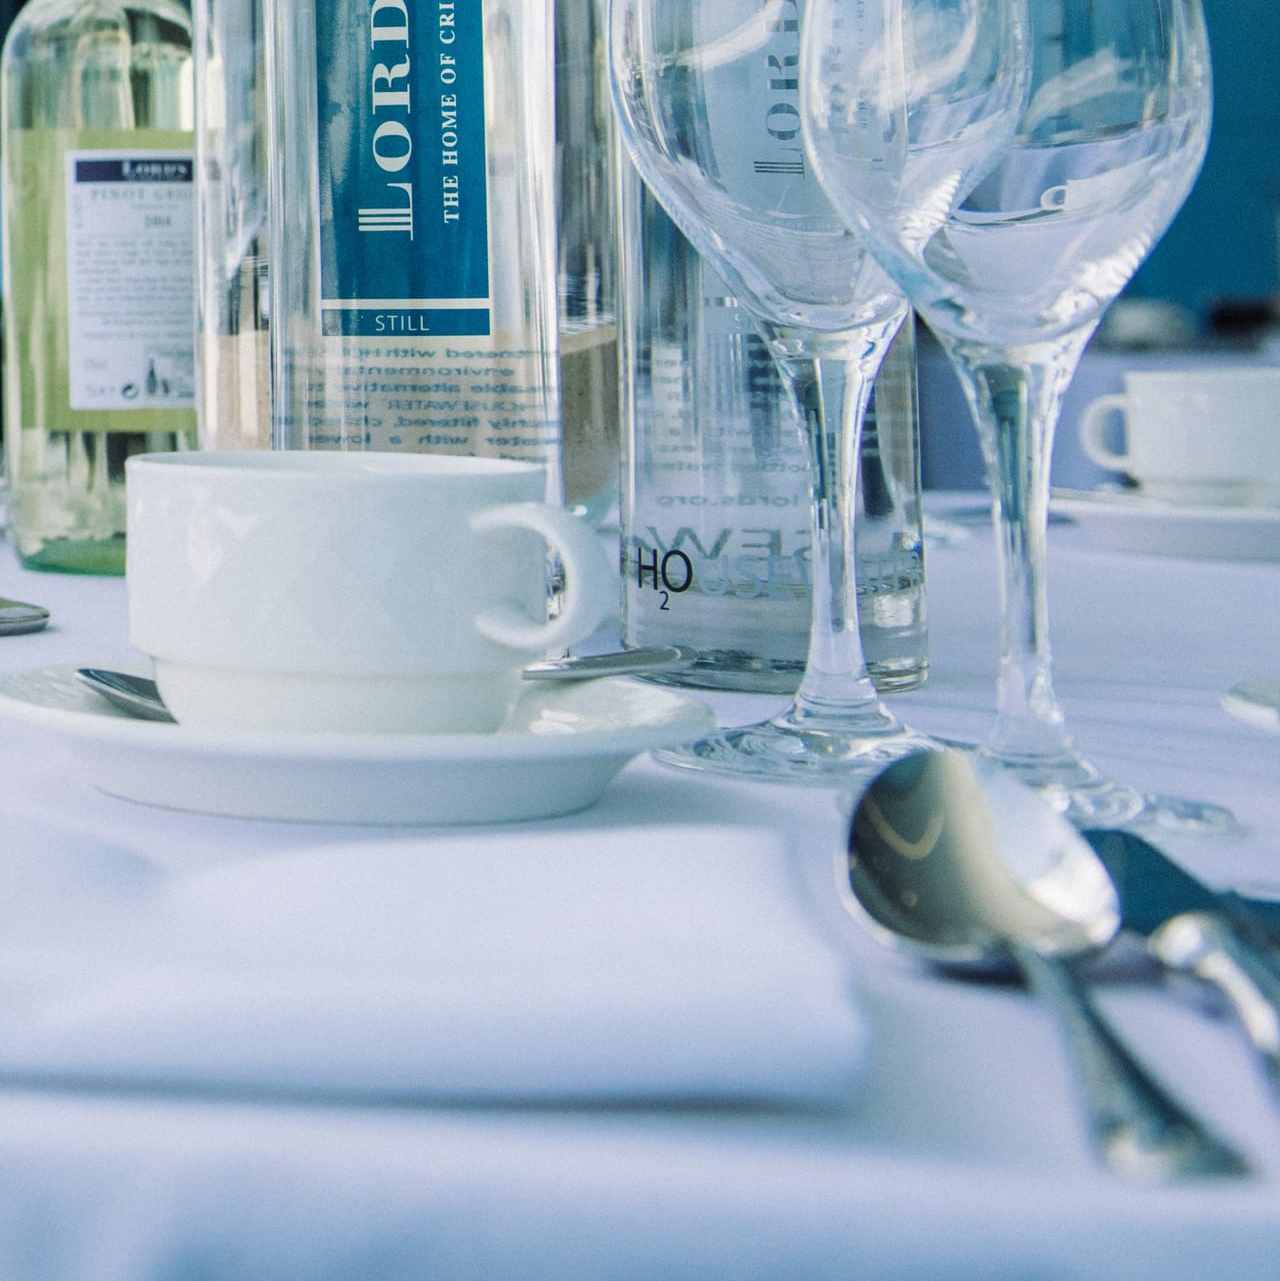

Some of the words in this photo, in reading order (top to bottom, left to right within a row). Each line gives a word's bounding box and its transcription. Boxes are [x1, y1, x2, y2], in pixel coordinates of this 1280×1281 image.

[440, 53, 457, 84] OF
[441, 94, 458, 165] HOME
[443, 175, 460, 224] THE
[375, 314, 430, 331] STILL
